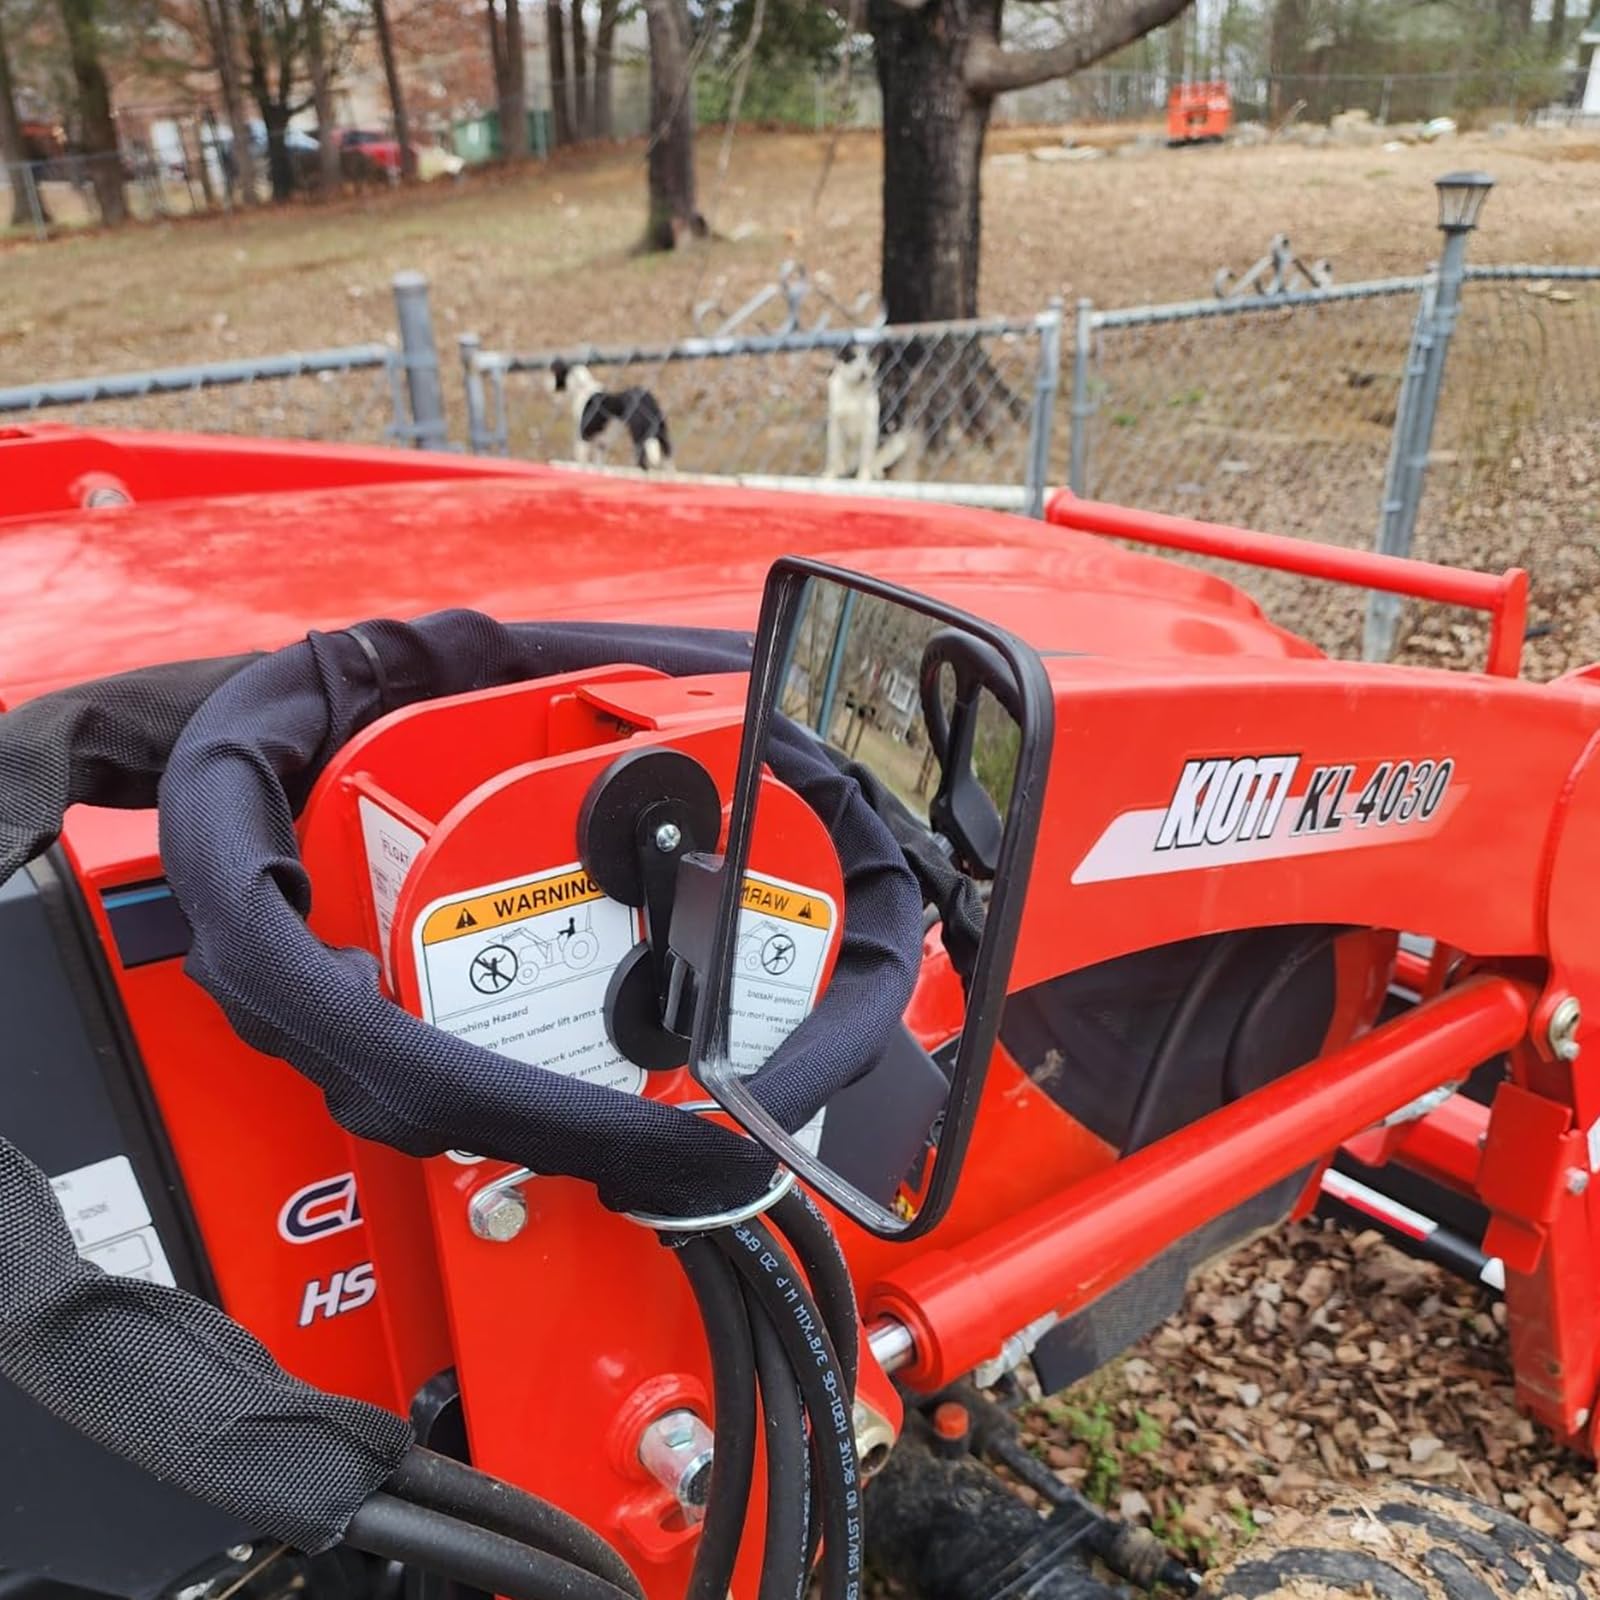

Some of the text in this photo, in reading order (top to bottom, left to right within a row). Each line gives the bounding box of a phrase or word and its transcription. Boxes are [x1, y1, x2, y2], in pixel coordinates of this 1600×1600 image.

[1153, 752, 1455, 851] KIOTI KL 4030
[446, 1006, 530, 1037] rushing Hazard
[501, 1031, 525, 1046] from
[527, 1021, 556, 1038] under
[557, 1016, 571, 1028] lift
[572, 1009, 597, 1023] arms
[541, 1054, 565, 1067] work
[568, 1042, 596, 1058] under
[822, 1370, 849, 1434] H301-06
[839, 1437, 856, 1485] SKIVE
